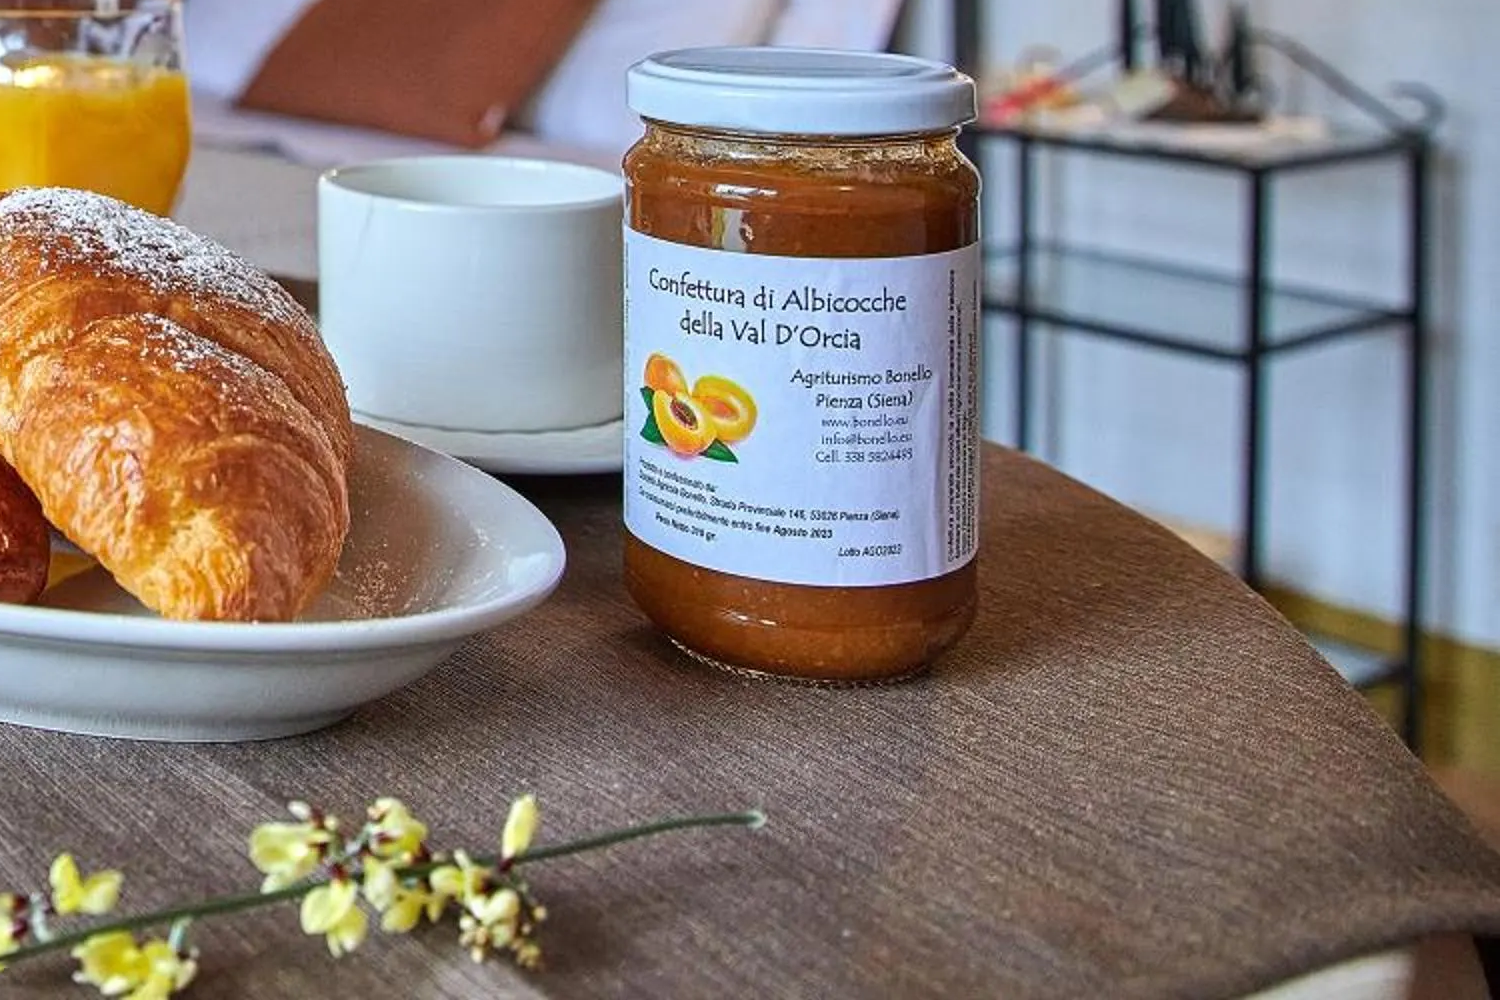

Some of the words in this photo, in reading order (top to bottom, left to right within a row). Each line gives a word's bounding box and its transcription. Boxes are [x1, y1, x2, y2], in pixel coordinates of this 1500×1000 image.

[649, 268, 745, 308] Confettura
[753, 285, 774, 311] di
[781, 286, 907, 313] Albicocche
[679, 310, 723, 340] della
[731, 319, 766, 345] Val
[776, 323, 861, 350] D'Orcia
[790, 368, 882, 388] Agriturismo
[885, 364, 933, 384] Bonello
[816, 393, 863, 409] Pienza
[867, 390, 913, 409] (Siena)
